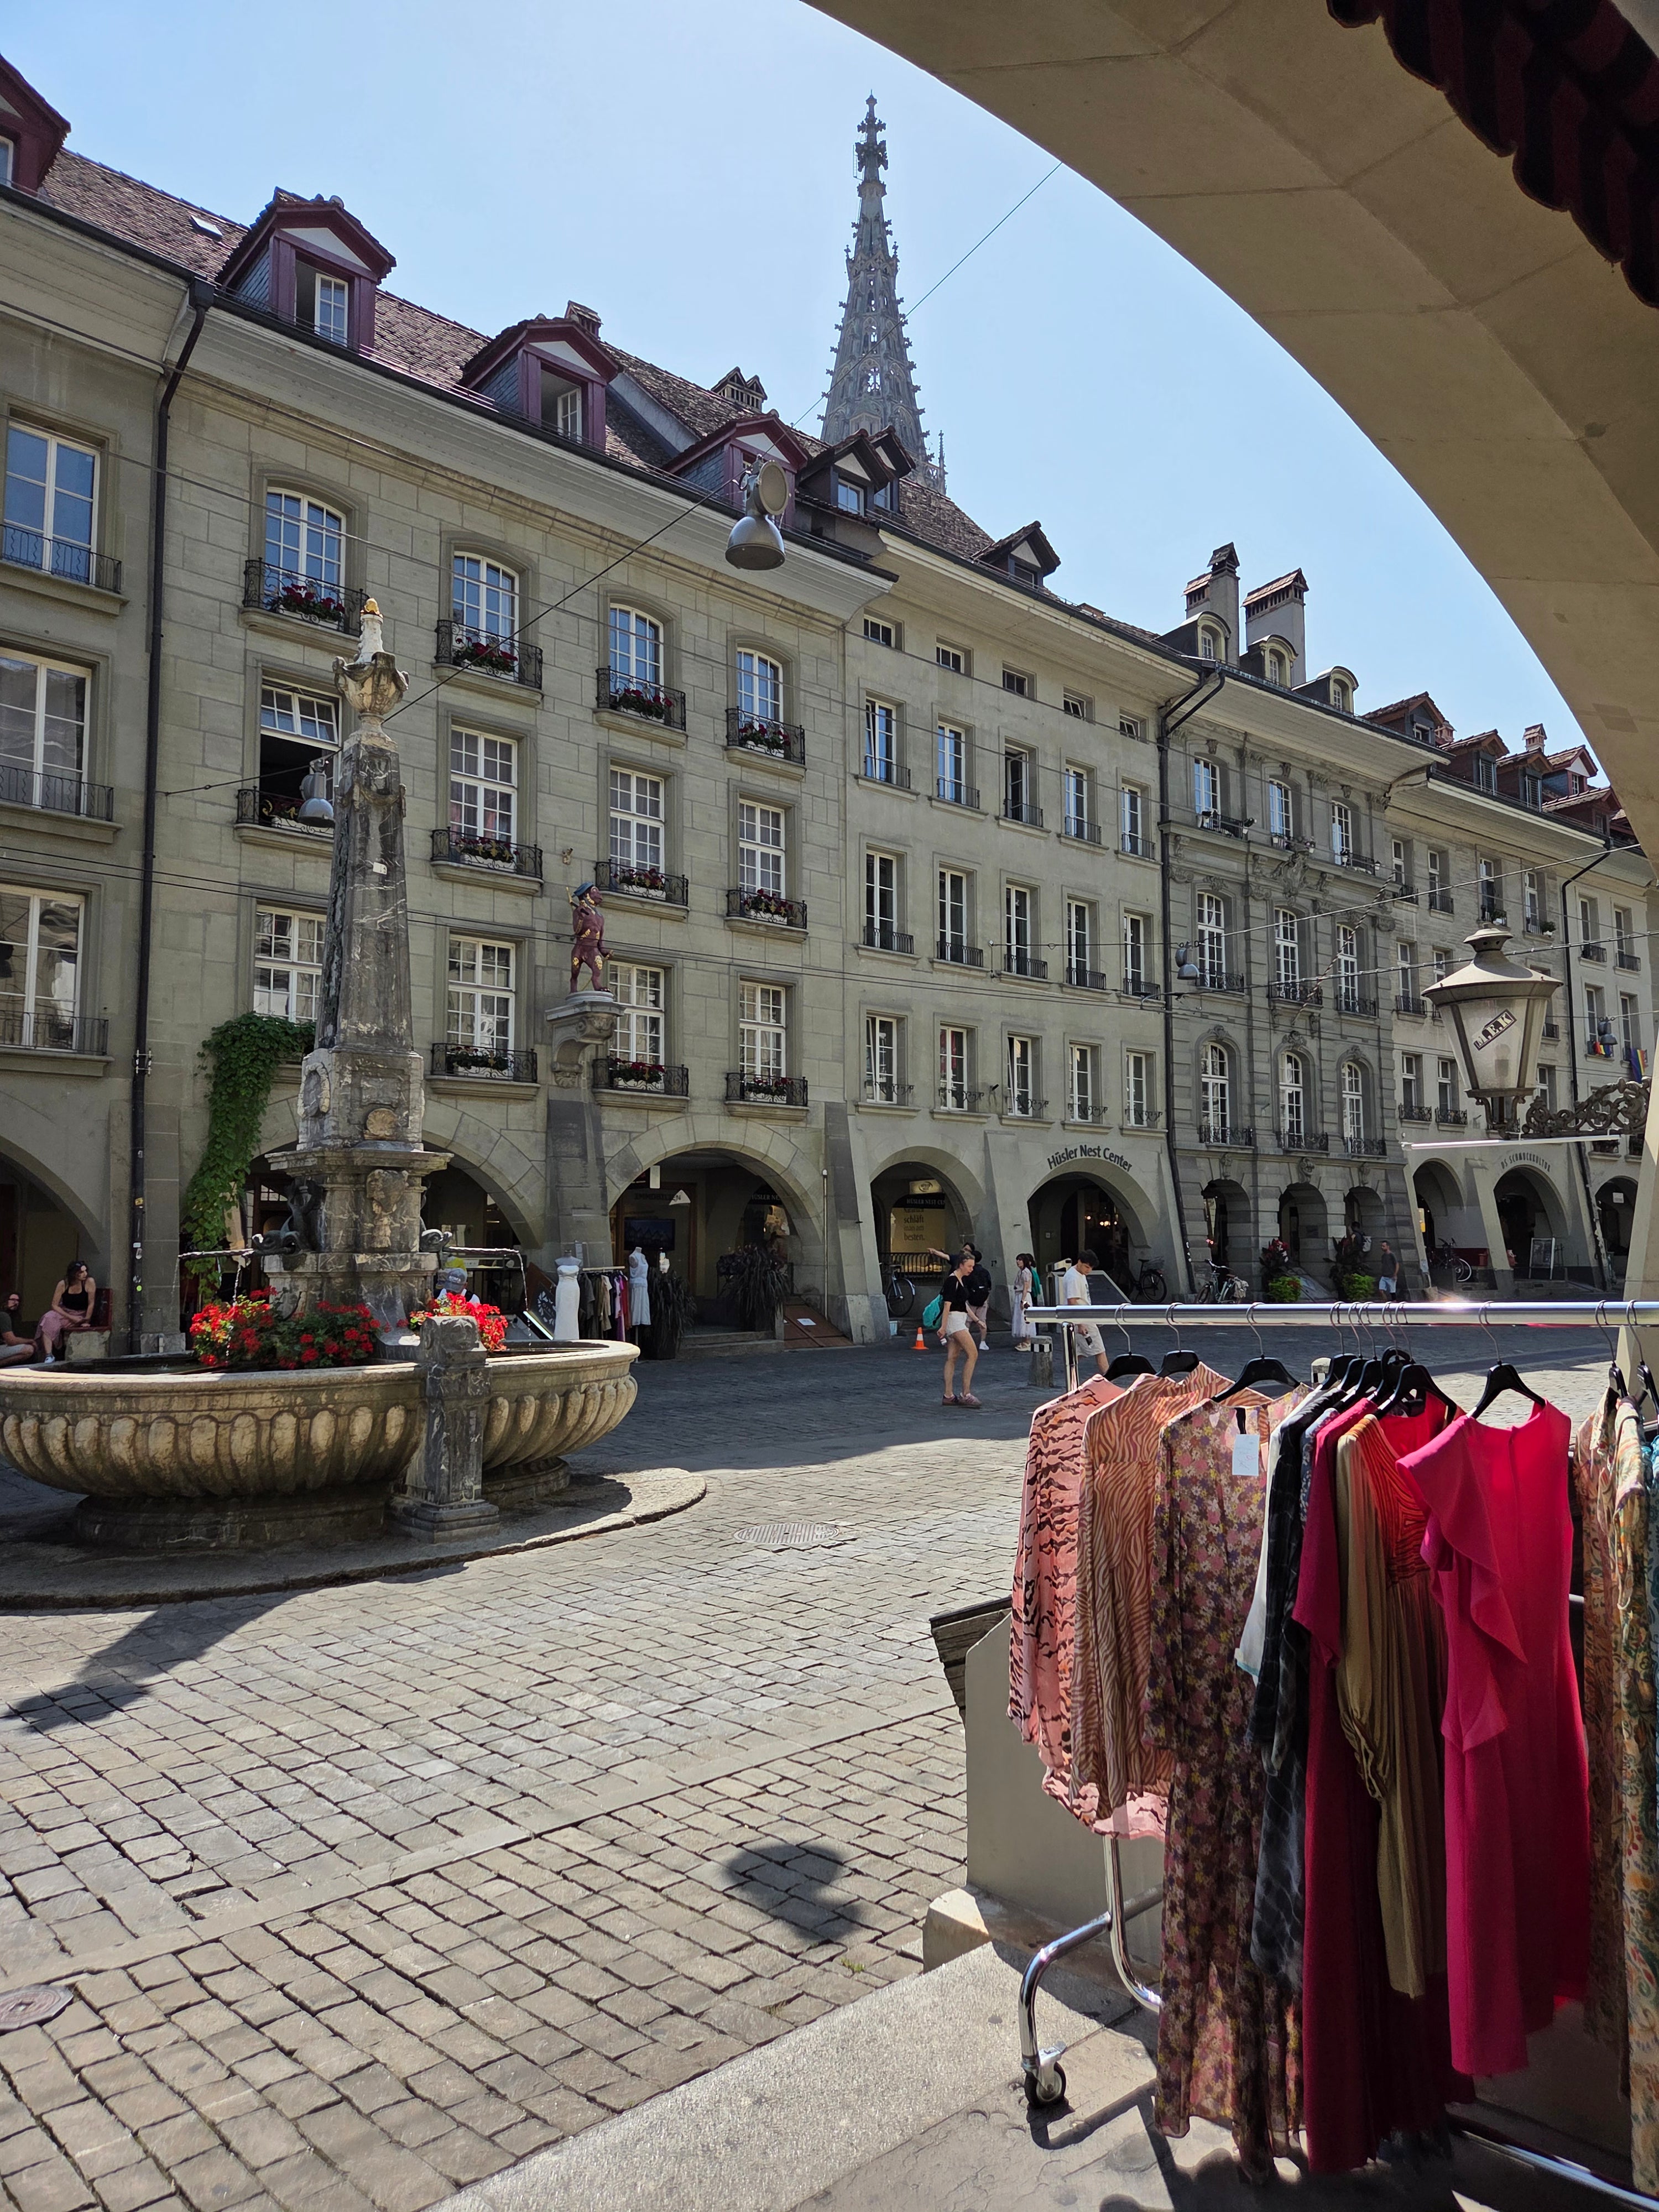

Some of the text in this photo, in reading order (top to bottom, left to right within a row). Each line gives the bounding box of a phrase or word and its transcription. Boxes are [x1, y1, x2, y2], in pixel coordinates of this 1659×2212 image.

[1047, 1145, 1133, 1172] Hüsler Nest Center
[1509, 1152, 1551, 1172] SCHMUCKKULTUR
[904, 1214, 924, 1223] schläft
[904, 1233, 925, 1241] besten.
